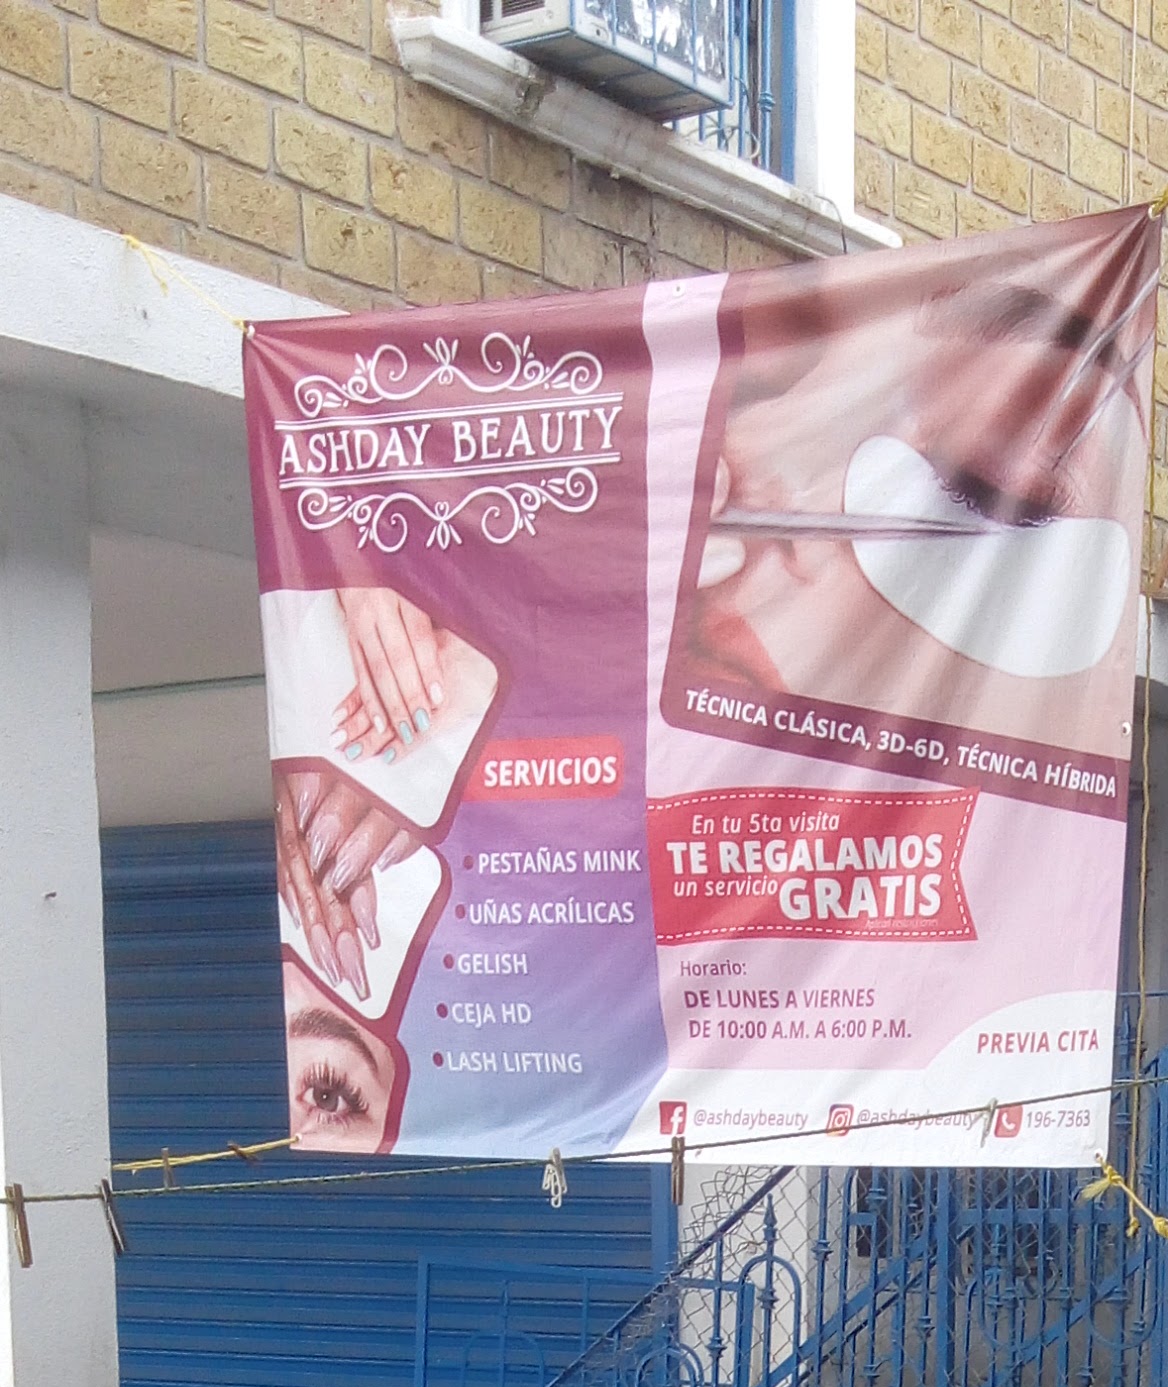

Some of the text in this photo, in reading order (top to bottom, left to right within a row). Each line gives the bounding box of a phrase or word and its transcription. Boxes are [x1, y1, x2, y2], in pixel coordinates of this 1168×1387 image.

[279, 406, 623, 475] ASHDAY BEAUTY
[686, 688, 1116, 798] TÉCNICA CLÁSICA, 3D-6D, TÉCNICA HÍBRIDA
[484, 756, 617, 787] SERVICIOS
[692, 811, 840, 835] En tu 5ta visita
[478, 847, 641, 874] PESTAÑAS MINK
[666, 834, 943, 874] TE REGALAMOS
[674, 873, 943, 920] un servicio GRATIS
[470, 898, 635, 925] UÑAS ACRÍLICAS
[458, 953, 528, 975] GELISH
[680, 959, 747, 977] Horario:
[684, 988, 875, 1009] DE LUNES A VIERNES
[452, 1003, 532, 1029] CEJA HD
[689, 1020, 912, 1039] DE 10:00 A.M. A 6:00 P.M.
[977, 1028, 1100, 1055] PREVIA CITA
[447, 1051, 583, 1075] LASH LIFTING
[694, 1108, 808, 1130] @ashdaybeauty
[1026, 1110, 1091, 1128] 196-7363
